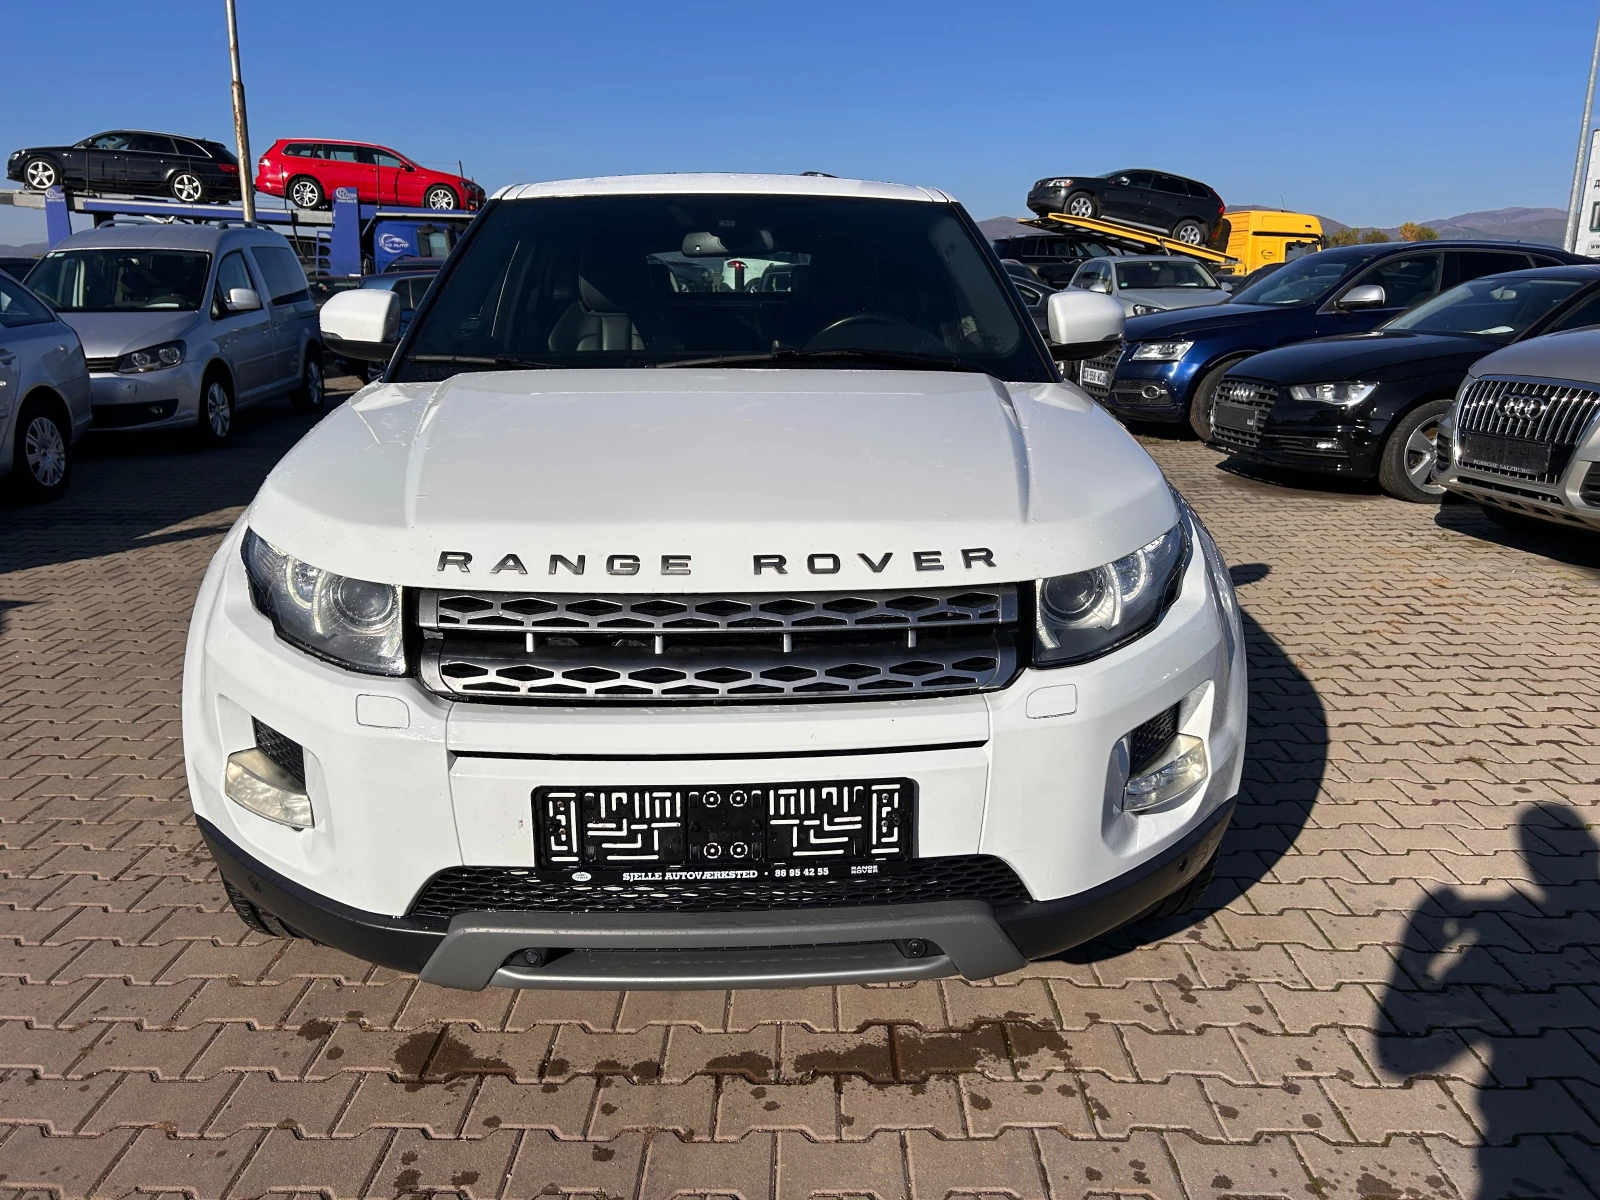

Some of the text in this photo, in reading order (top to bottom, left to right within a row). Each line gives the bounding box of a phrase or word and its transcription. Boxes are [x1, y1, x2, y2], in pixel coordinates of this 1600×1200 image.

[1473, 460, 1531, 474] PORSCHE SALZBURG
[437, 547, 997, 576] RANGE ROVER
[622, 867, 829, 882] SJELLE AUTOVÆRKSTED 86 95 42 55
